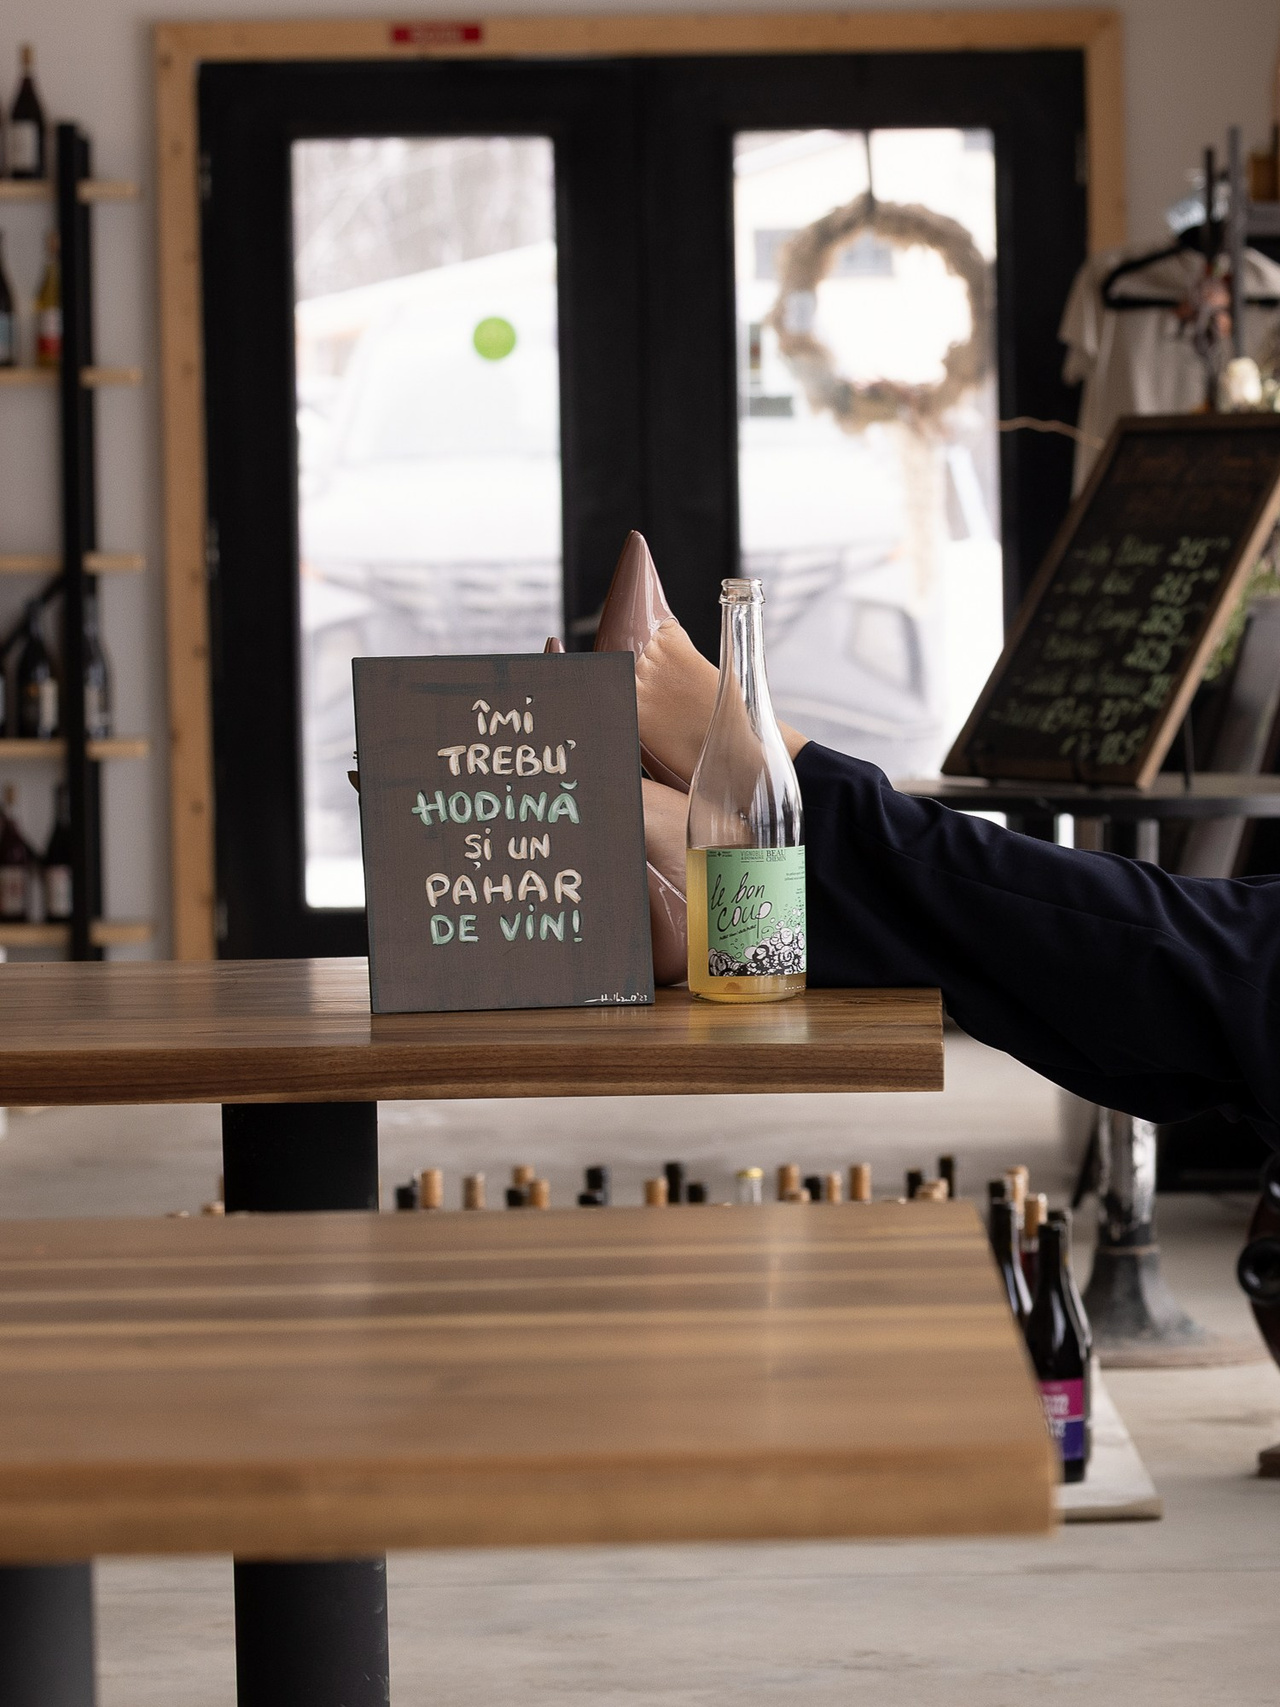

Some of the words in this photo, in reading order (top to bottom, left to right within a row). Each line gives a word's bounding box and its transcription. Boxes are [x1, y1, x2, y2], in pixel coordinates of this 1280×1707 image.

[507, 833, 550, 860] UN
[425, 869, 583, 908] PAHAR
[711, 873, 726, 910] le
[730, 871, 765, 904] bon
[430, 914, 480, 945] DE
[716, 900, 773, 939] coup
